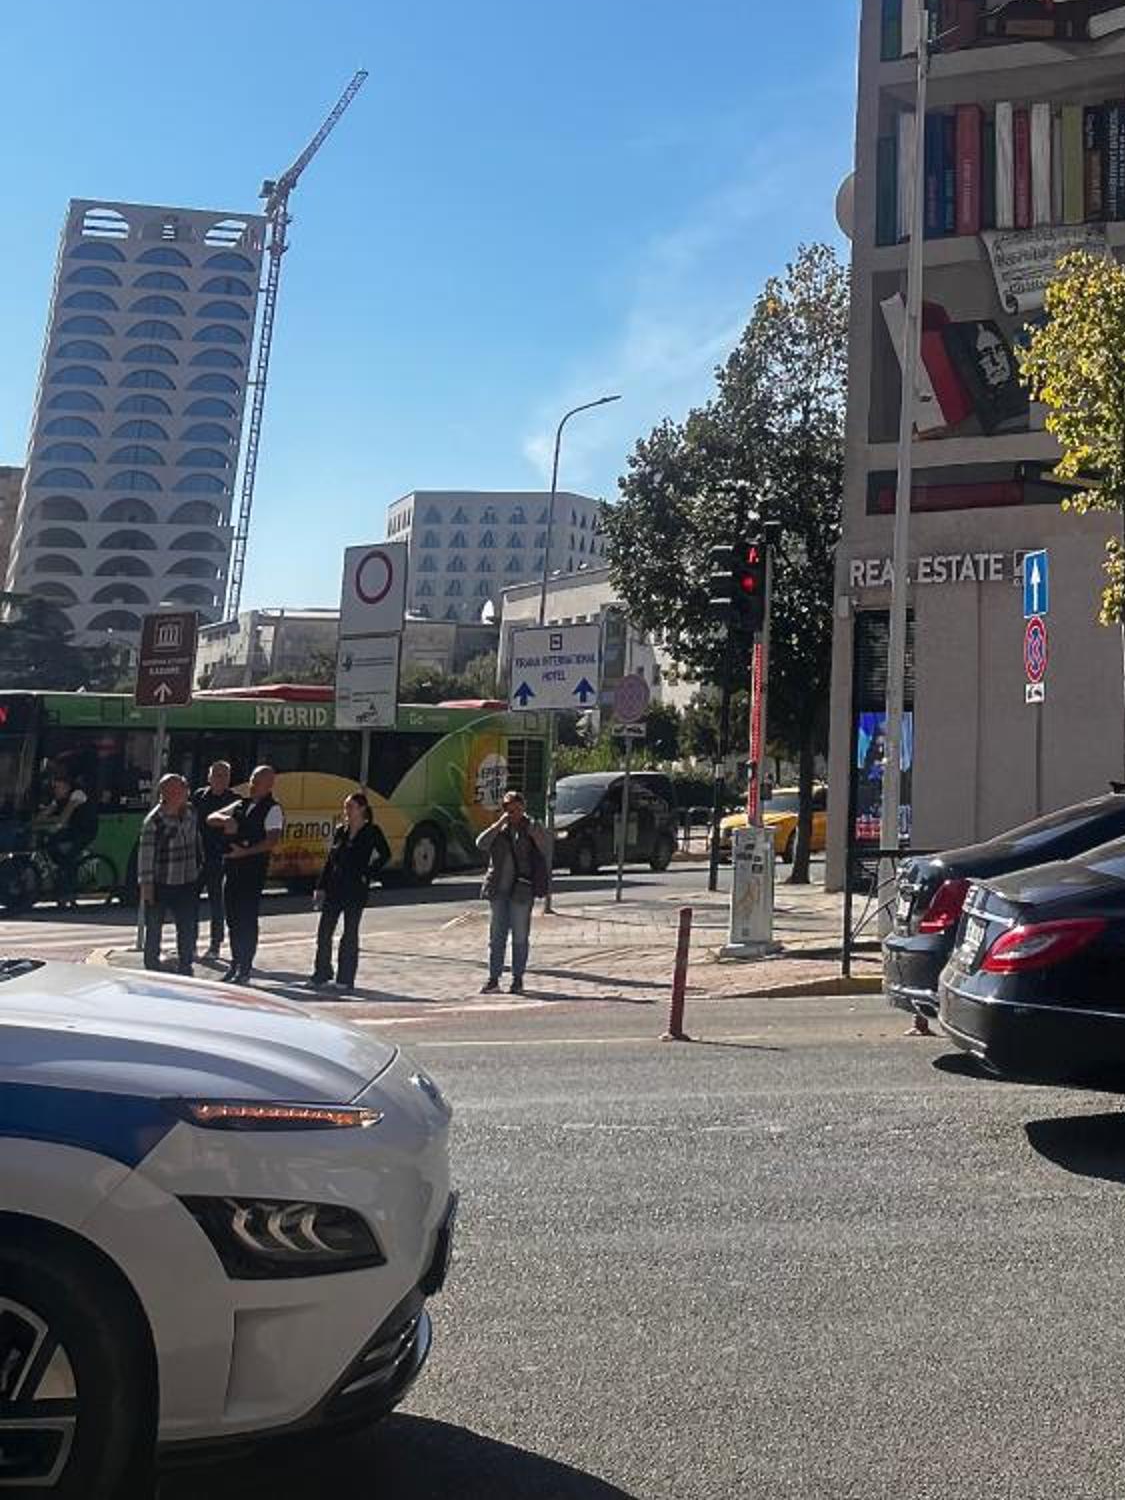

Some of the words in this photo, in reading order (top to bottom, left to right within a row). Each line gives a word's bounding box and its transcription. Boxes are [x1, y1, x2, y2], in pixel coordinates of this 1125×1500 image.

[850, 557, 911, 588] REA
[917, 553, 1004, 583] ESTATE
[255, 706, 328, 726] HYBRID
